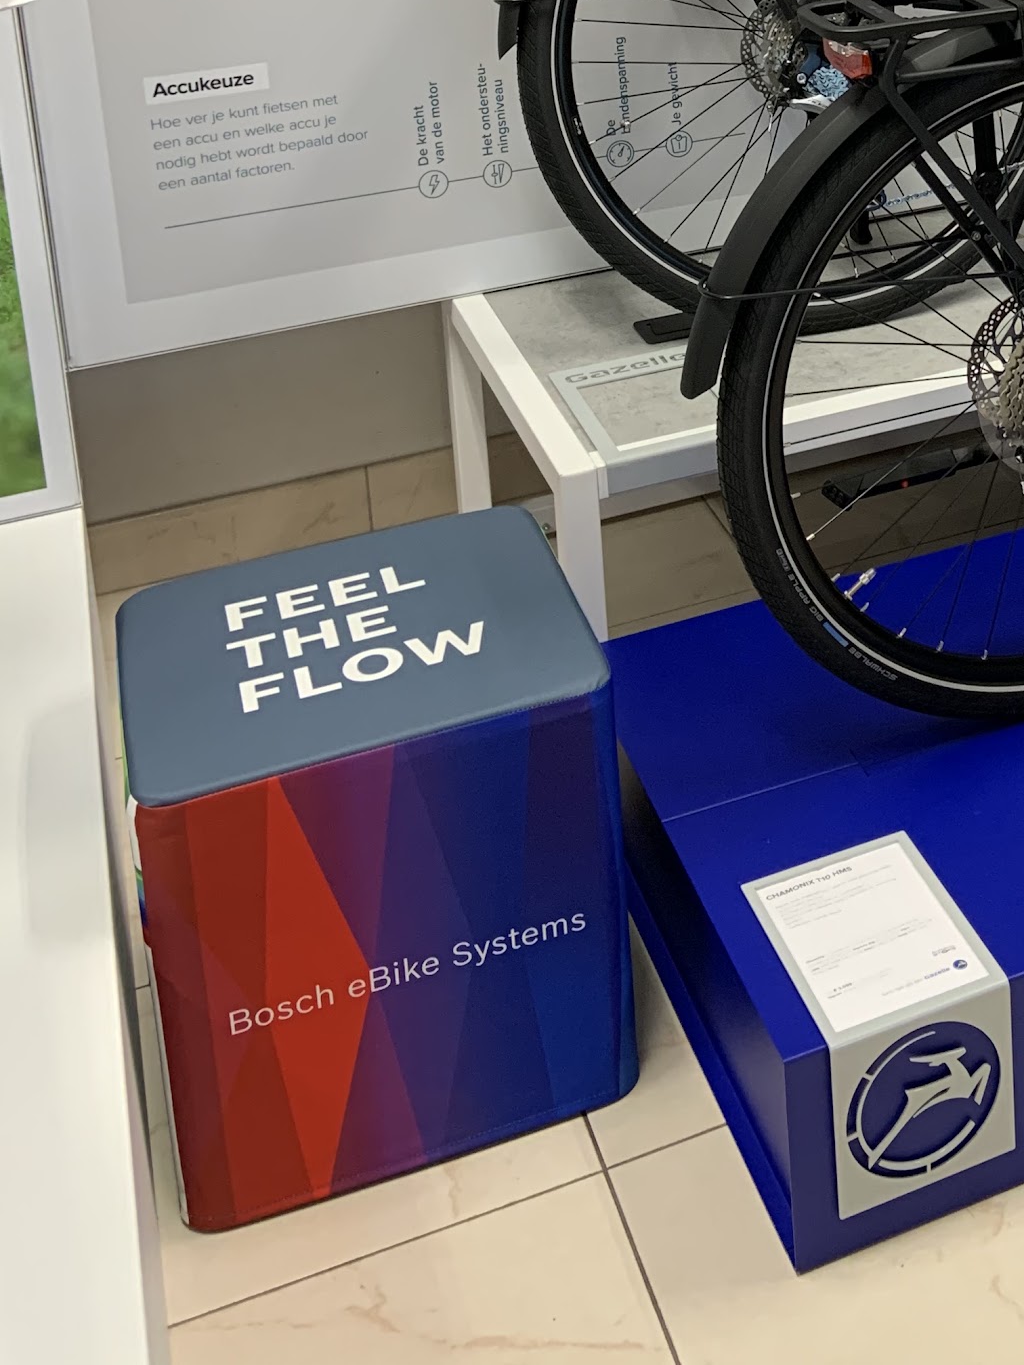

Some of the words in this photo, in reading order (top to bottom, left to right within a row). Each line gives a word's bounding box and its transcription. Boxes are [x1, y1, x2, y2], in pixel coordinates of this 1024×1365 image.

[153, 74, 254, 97] Accukeuze
[429, 81, 441, 117] motor
[477, 63, 491, 130] ondersteu-
[413, 104, 428, 145] kracht
[432, 122, 443, 139] de
[494, 79, 510, 153] ningsniveau
[671, 112, 682, 125] Je
[418, 148, 429, 166] De
[434, 141, 445, 164] van
[482, 133, 493, 156] Het
[565, 352, 687, 383] Gazelle
[225, 566, 426, 632] FEEL
[226, 605, 397, 668] THE
[239, 620, 484, 713] FLOW
[848, 646, 898, 681] SCHWALBE
[766, 879, 815, 901] CHAMONIX
[832, 866, 853, 877] HMS
[228, 984, 335, 1035] Bosch
[347, 956, 440, 998] eBike
[452, 912, 587, 967] Systems
